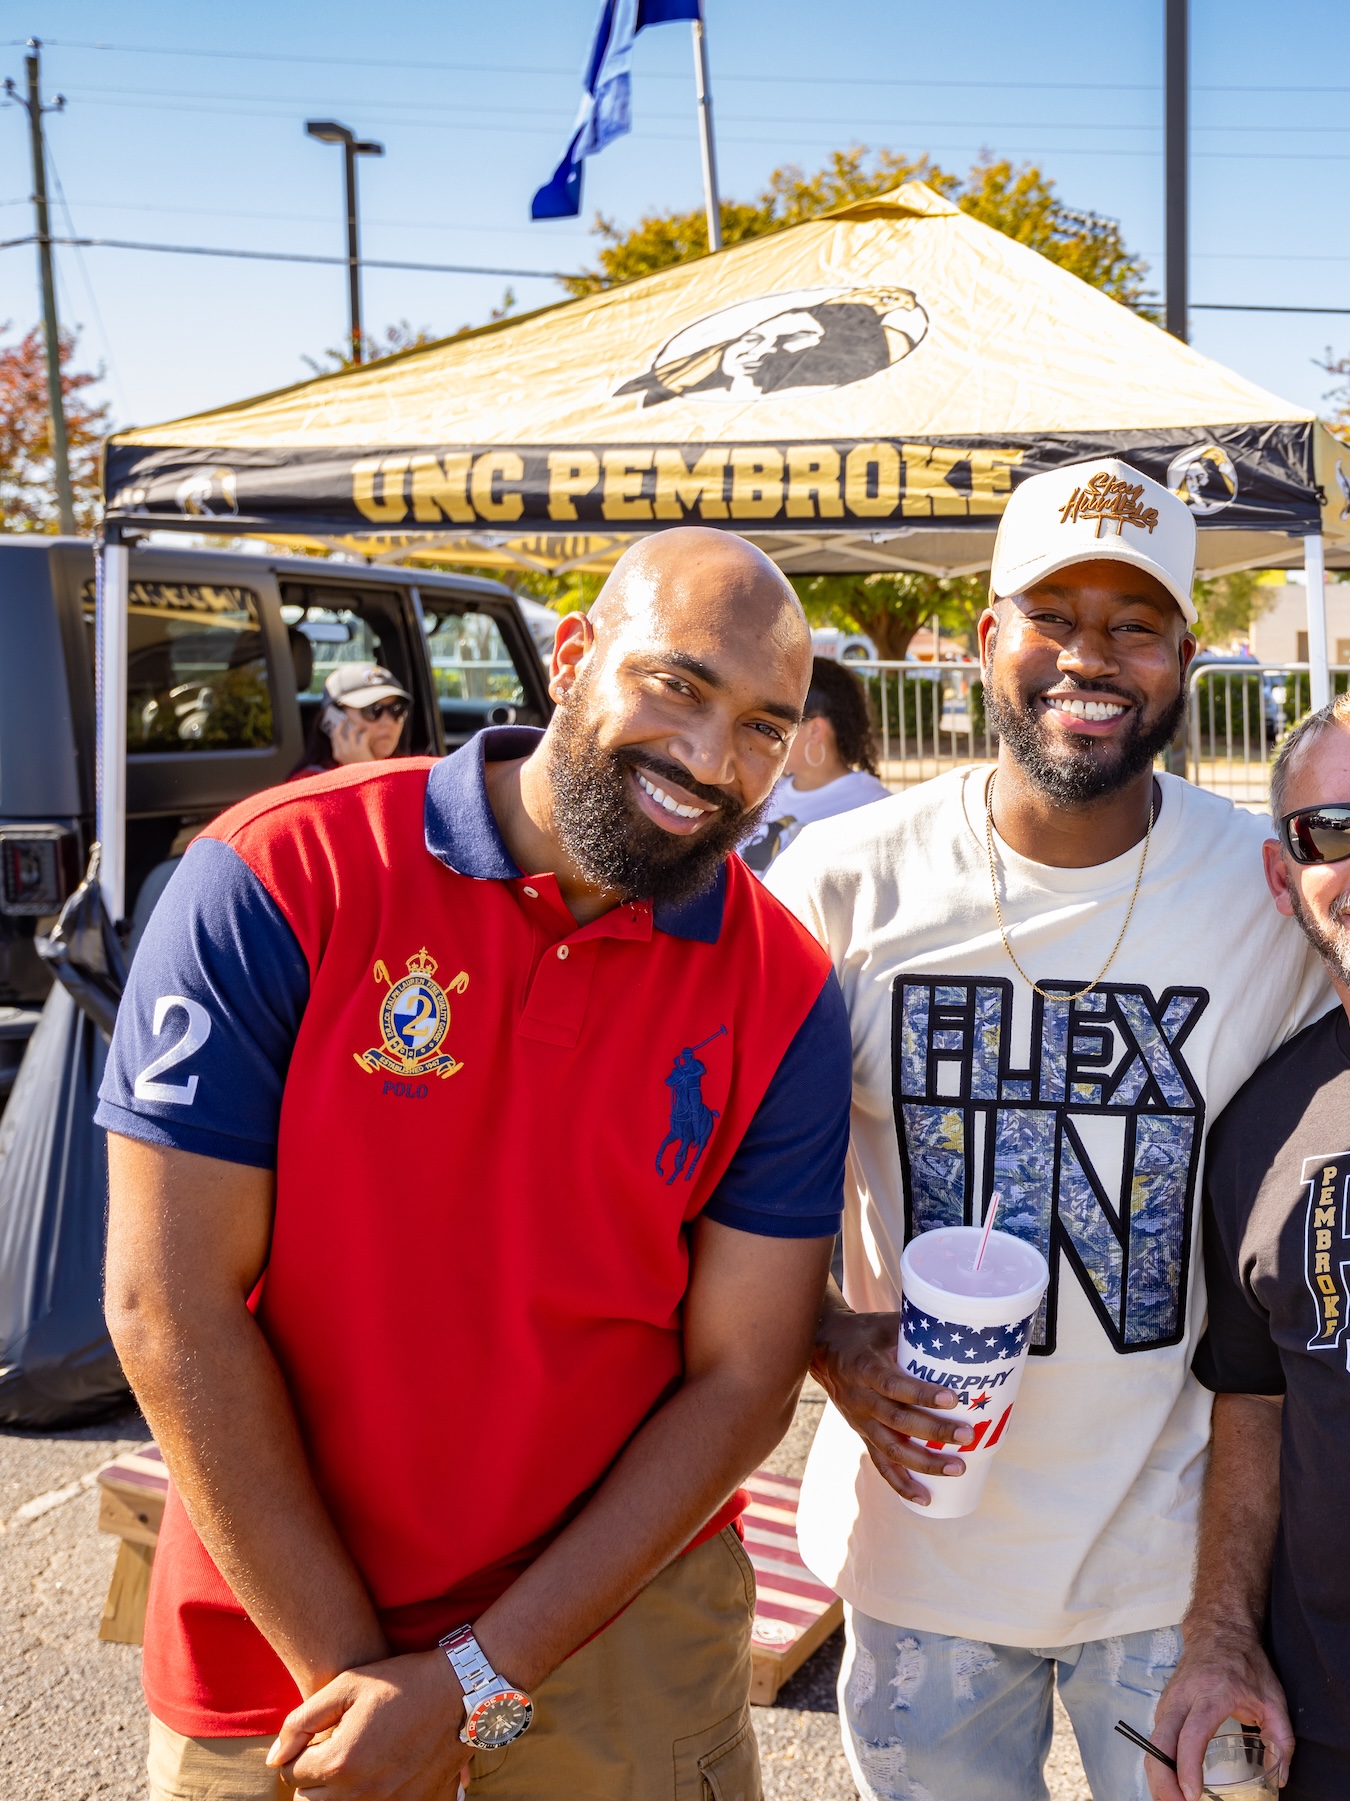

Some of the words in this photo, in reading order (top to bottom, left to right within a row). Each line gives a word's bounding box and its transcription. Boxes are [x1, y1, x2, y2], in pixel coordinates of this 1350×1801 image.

[351, 451, 525, 524] UNC
[547, 442, 1024, 520] PEMBROKE
[386, 988, 400, 1011] RALPH
[399, 978, 425, 991] LAUREN
[402, 995, 433, 1036] 2
[134, 995, 212, 1105] 2
[892, 974, 1210, 1112] FLEX
[382, 1080, 428, 1098] POLO
[894, 1100, 1204, 1356] IN
[906, 1359, 1016, 1390] MURPHY
